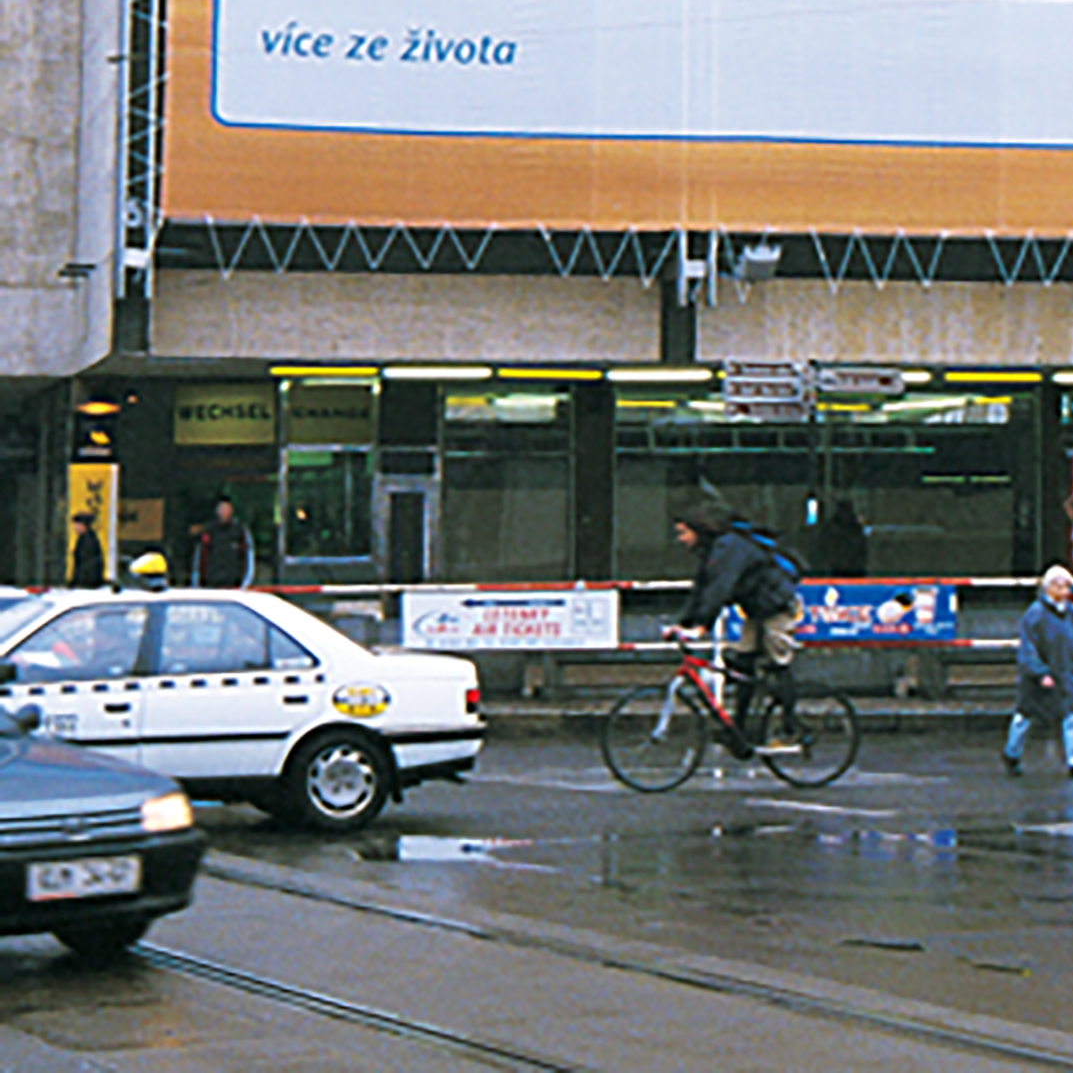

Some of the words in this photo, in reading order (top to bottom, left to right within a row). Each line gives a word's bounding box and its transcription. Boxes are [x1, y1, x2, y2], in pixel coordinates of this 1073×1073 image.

[261, 21, 334, 58] více
[345, 35, 389, 61] ze
[400, 28, 517, 65] života
[180, 404, 271, 421] WECHSEL
